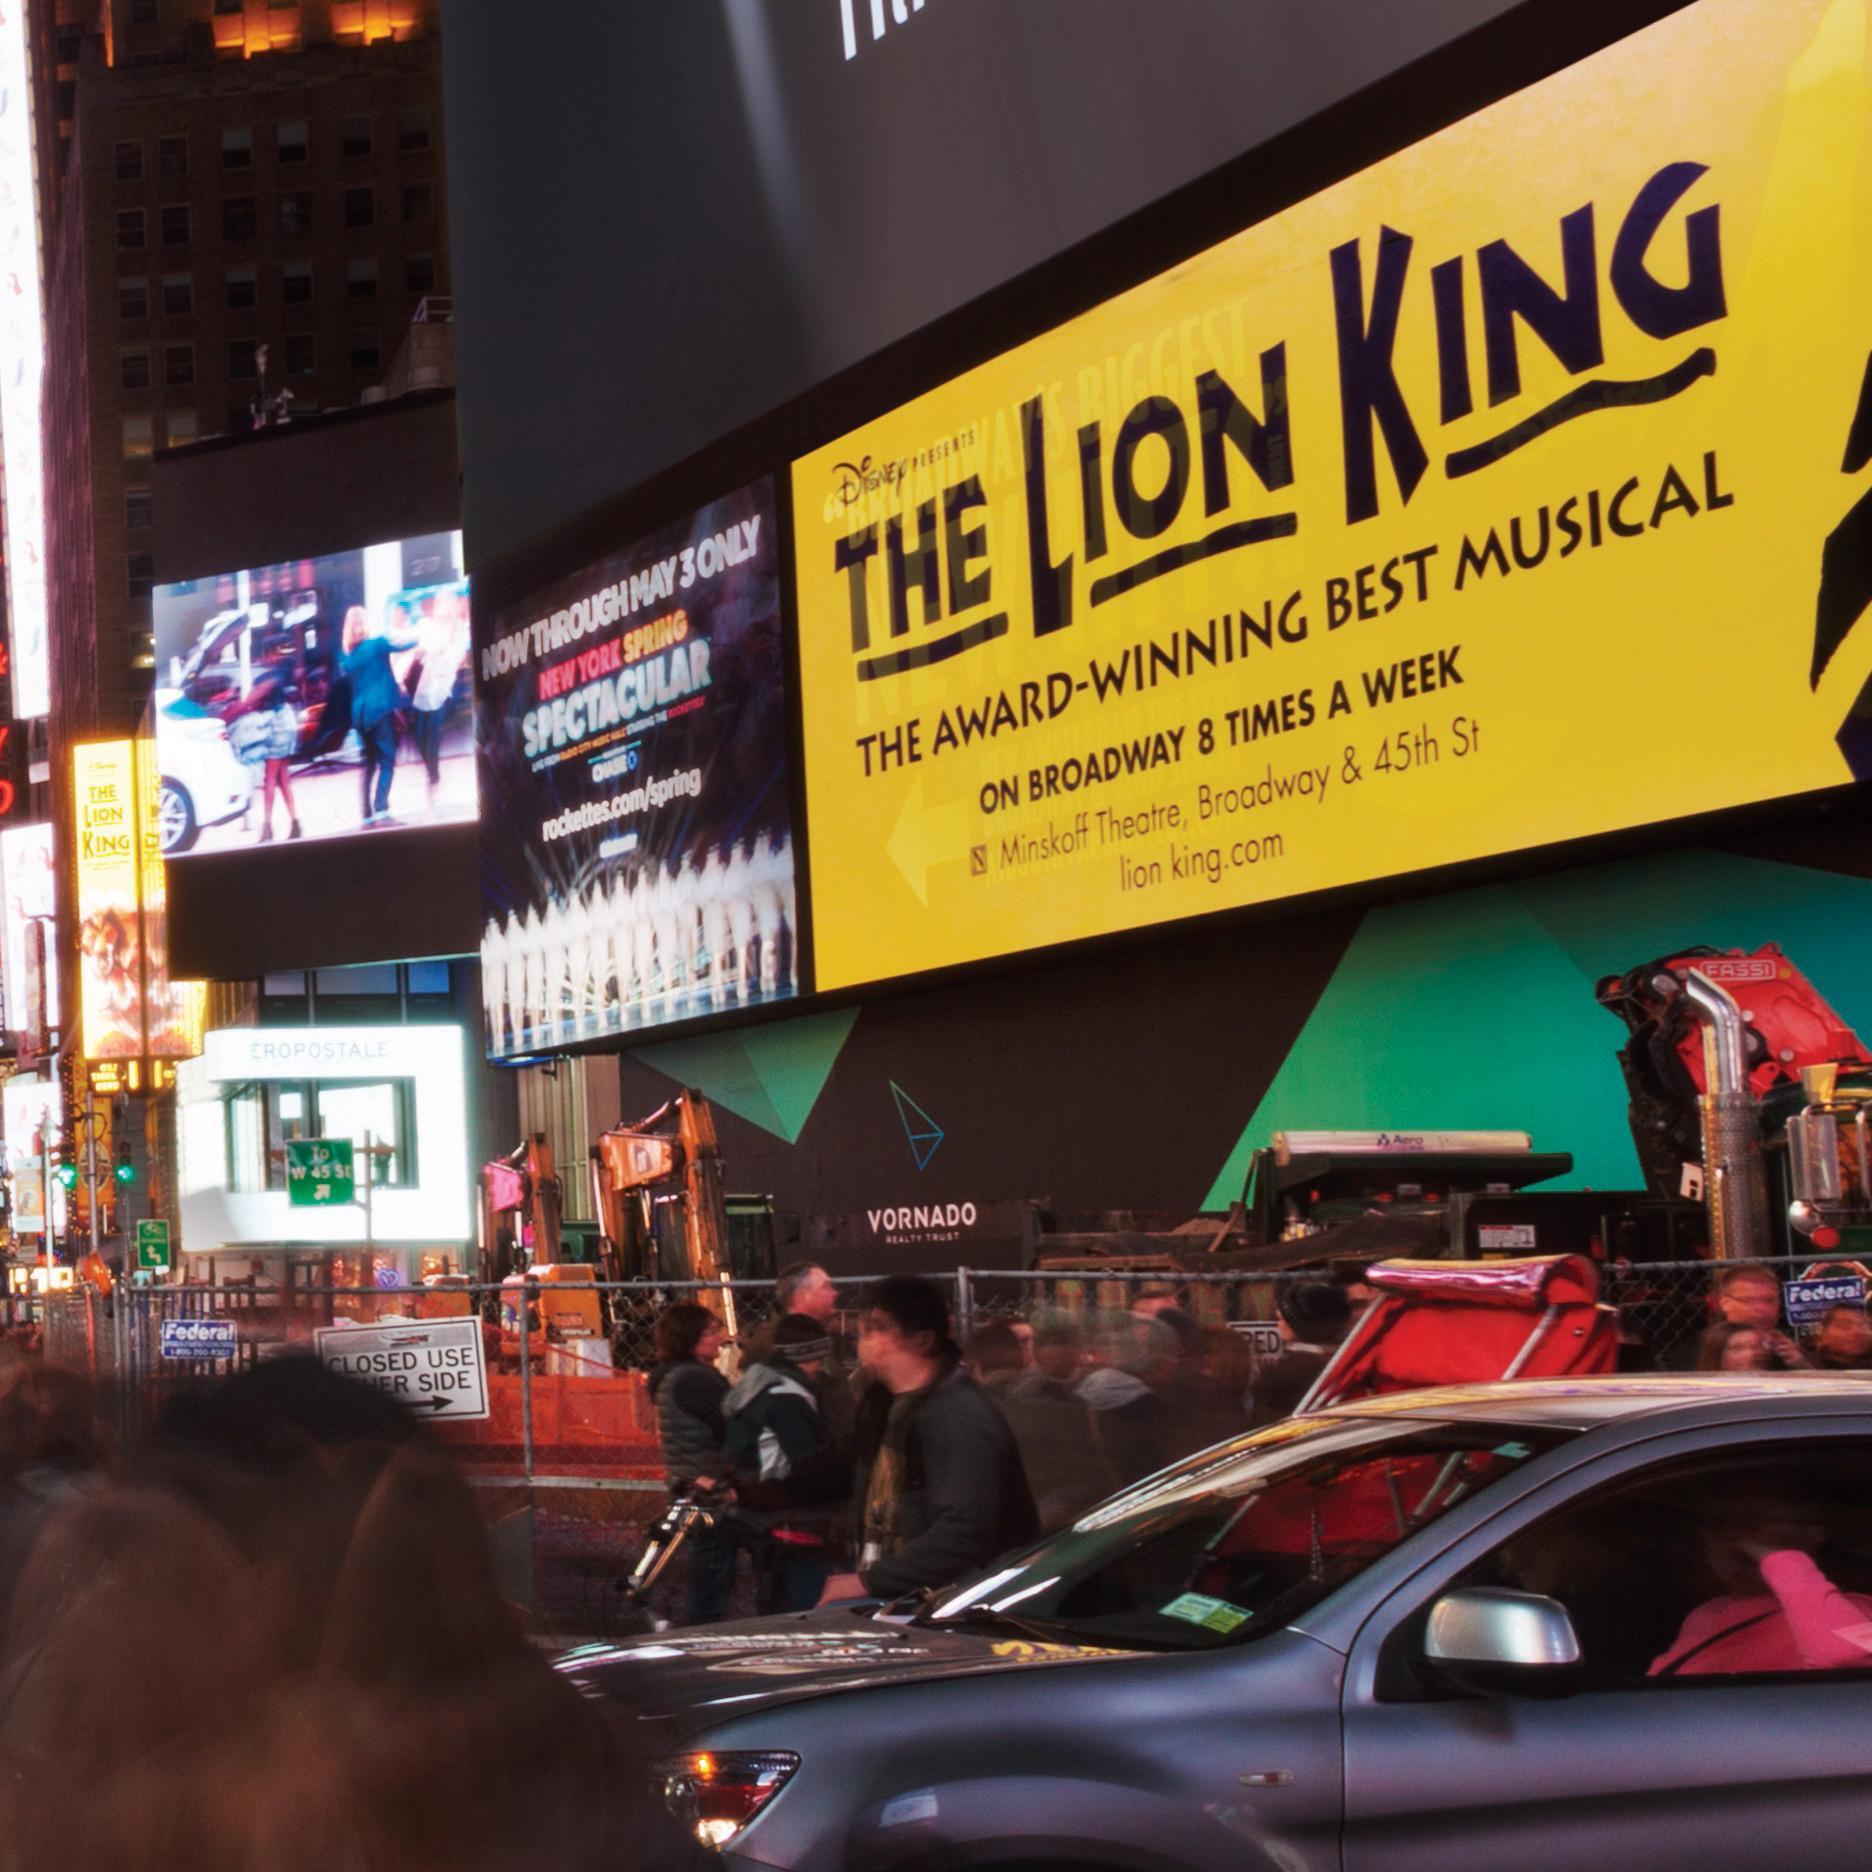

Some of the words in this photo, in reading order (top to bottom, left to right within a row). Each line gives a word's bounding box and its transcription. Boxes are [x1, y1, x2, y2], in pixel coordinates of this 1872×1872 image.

[911, 429, 975, 473] PRESENTS
[834, 473, 994, 655] THE
[482, 627, 529, 681] NOW
[530, 579, 629, 657] THROUGH
[629, 555, 677, 613] MAY
[679, 546, 696, 589] 3
[696, 514, 761, 578] ONLY
[856, 717, 923, 778] THE
[931, 592, 1310, 758] AWARD-WINNING
[1324, 546, 1441, 632] BEST
[1452, 450, 1735, 591] MUSICAL
[537, 657, 576, 701] NEW
[577, 636, 622, 683] YORK
[622, 608, 688, 665] SPRING
[522, 637, 712, 759] SPECTACULAR
[979, 775, 1020, 815] ON
[1028, 724, 1187, 804] BROADWAY
[1197, 716, 1216, 757] 8
[1224, 688, 1317, 747] TIMES
[1326, 679, 1353, 719] A
[1363, 644, 1465, 709] WEEK
[89, 784, 116, 800] THE
[542, 766, 702, 842] rockettes.com/spring
[998, 810, 1089, 870] Minskoff
[1094, 801, 1190, 844] Theatre,
[1197, 763, 1331, 823] Broadway
[1340, 744, 1364, 786] &
[1373, 720, 1439, 775] 45th
[1450, 715, 1481, 756] St
[1119, 852, 1163, 892] lion
[1169, 831, 1286, 885] king.com
[1704, 962, 1773, 979] FASSI
[290, 1166, 305, 1179] W
[311, 1164, 330, 1179] 45
[335, 1163, 352, 1179] St
[311, 1146, 330, 1161] To
[867, 1201, 977, 1234] VORNADO
[885, 1234, 921, 1245] REALTY
[924, 1231, 960, 1243] TRUST
[1789, 1285, 1862, 1303] Federal
[163, 1321, 235, 1342] Federal
[328, 1346, 418, 1375] CLOSED
[426, 1346, 475, 1369] USE
[417, 1369, 474, 1391] SIDE
